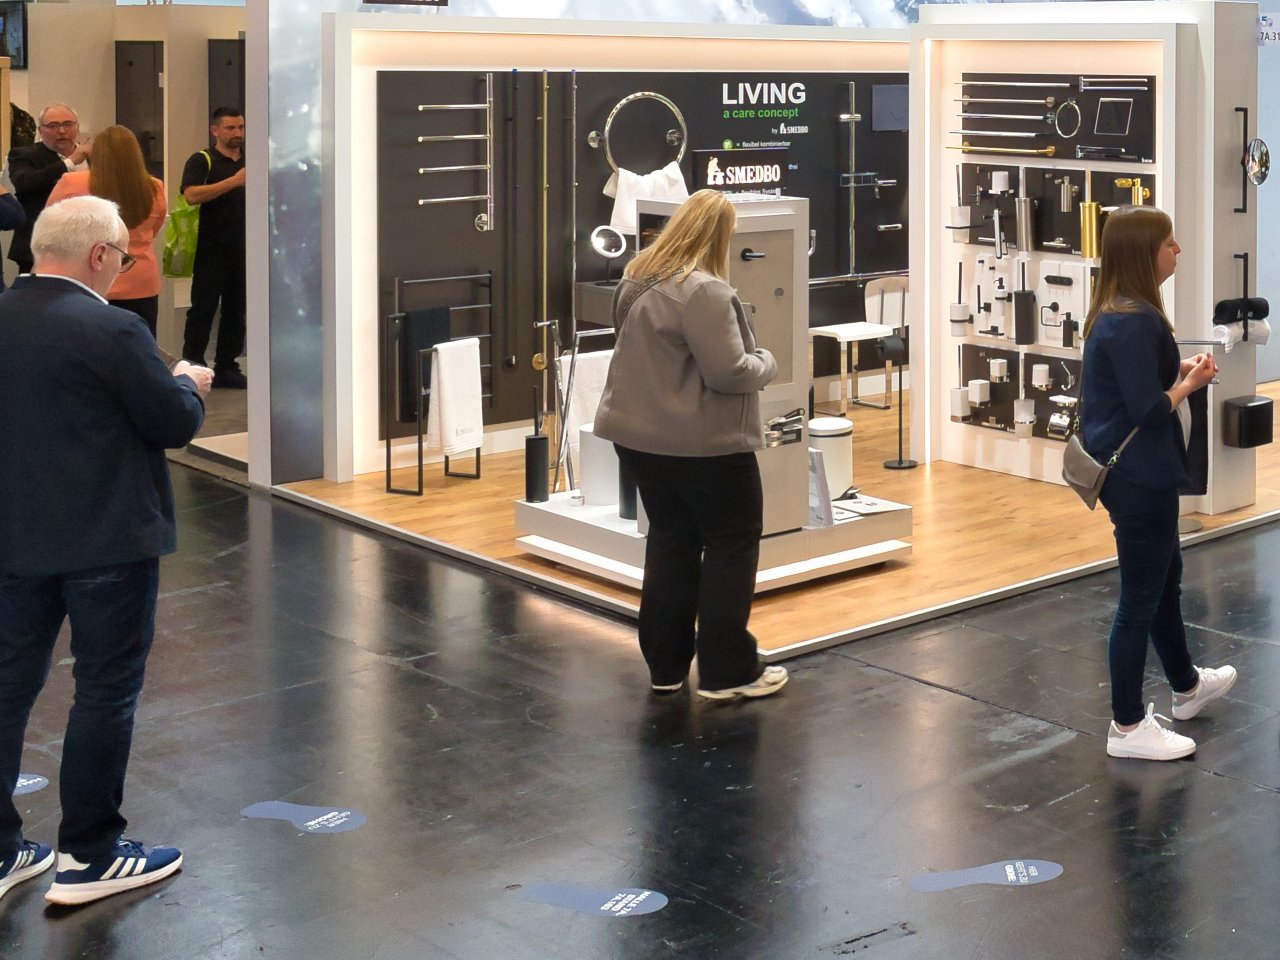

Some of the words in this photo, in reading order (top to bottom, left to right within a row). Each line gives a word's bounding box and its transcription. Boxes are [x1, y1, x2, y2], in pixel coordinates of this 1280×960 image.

[722, 82, 806, 104] LIVING
[723, 110, 730, 118] a
[732, 109, 755, 118] care
[758, 107, 799, 119] concept
[787, 126, 809, 134] SMEDBO
[725, 164, 781, 184] SMEDBO
